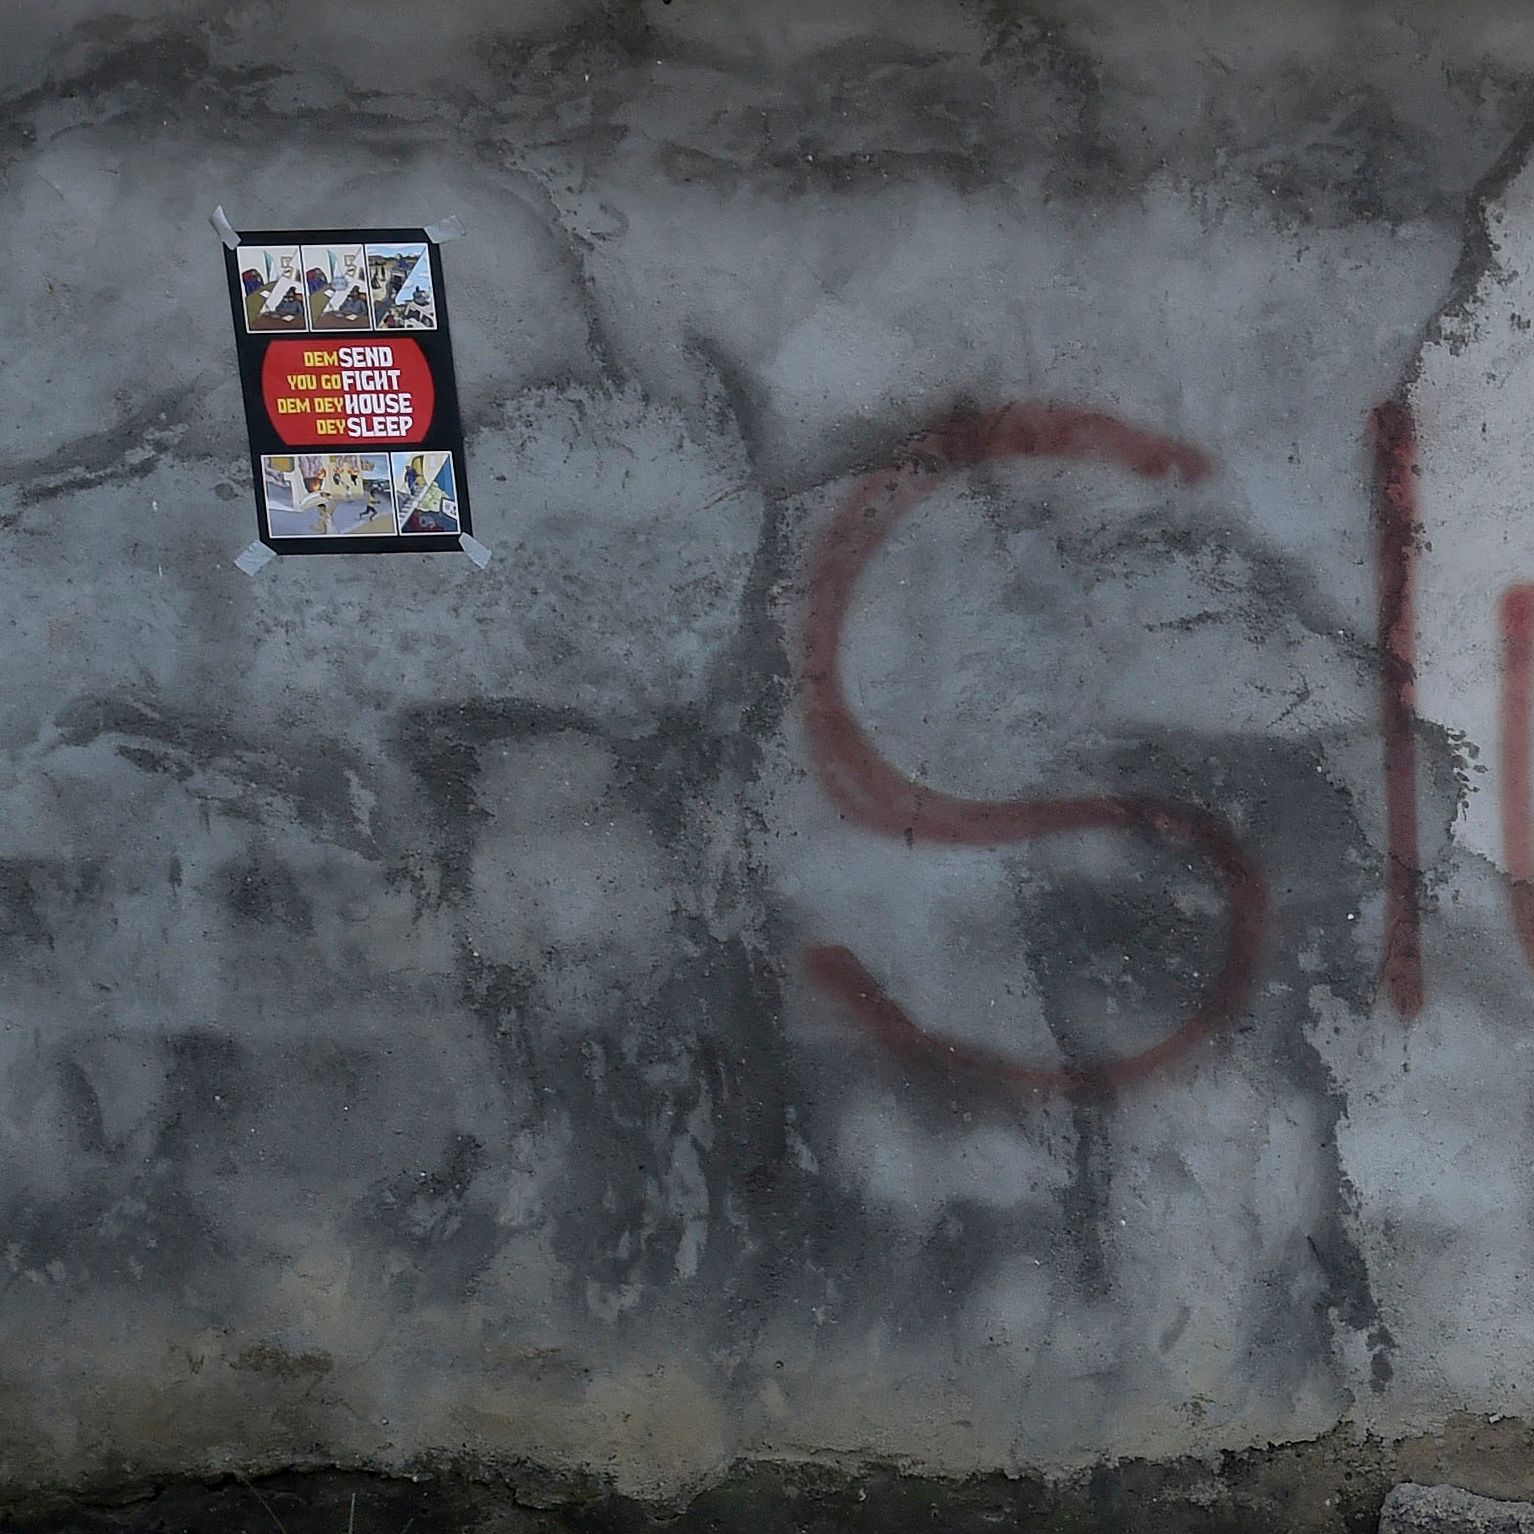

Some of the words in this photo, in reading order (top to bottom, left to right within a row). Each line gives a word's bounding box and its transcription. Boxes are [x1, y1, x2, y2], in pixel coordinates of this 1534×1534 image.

[303, 351, 339, 367] DEM
[339, 346, 394, 368] SEND
[286, 374, 317, 390] YOU
[320, 374, 342, 390] GO
[341, 369, 401, 391] FIGHT
[276, 398, 312, 414] DEM
[314, 397, 344, 413] DEY
[344, 393, 413, 415] HOUSE
[316, 419, 346, 435] DEY
[346, 416, 413, 437] SLEEP
